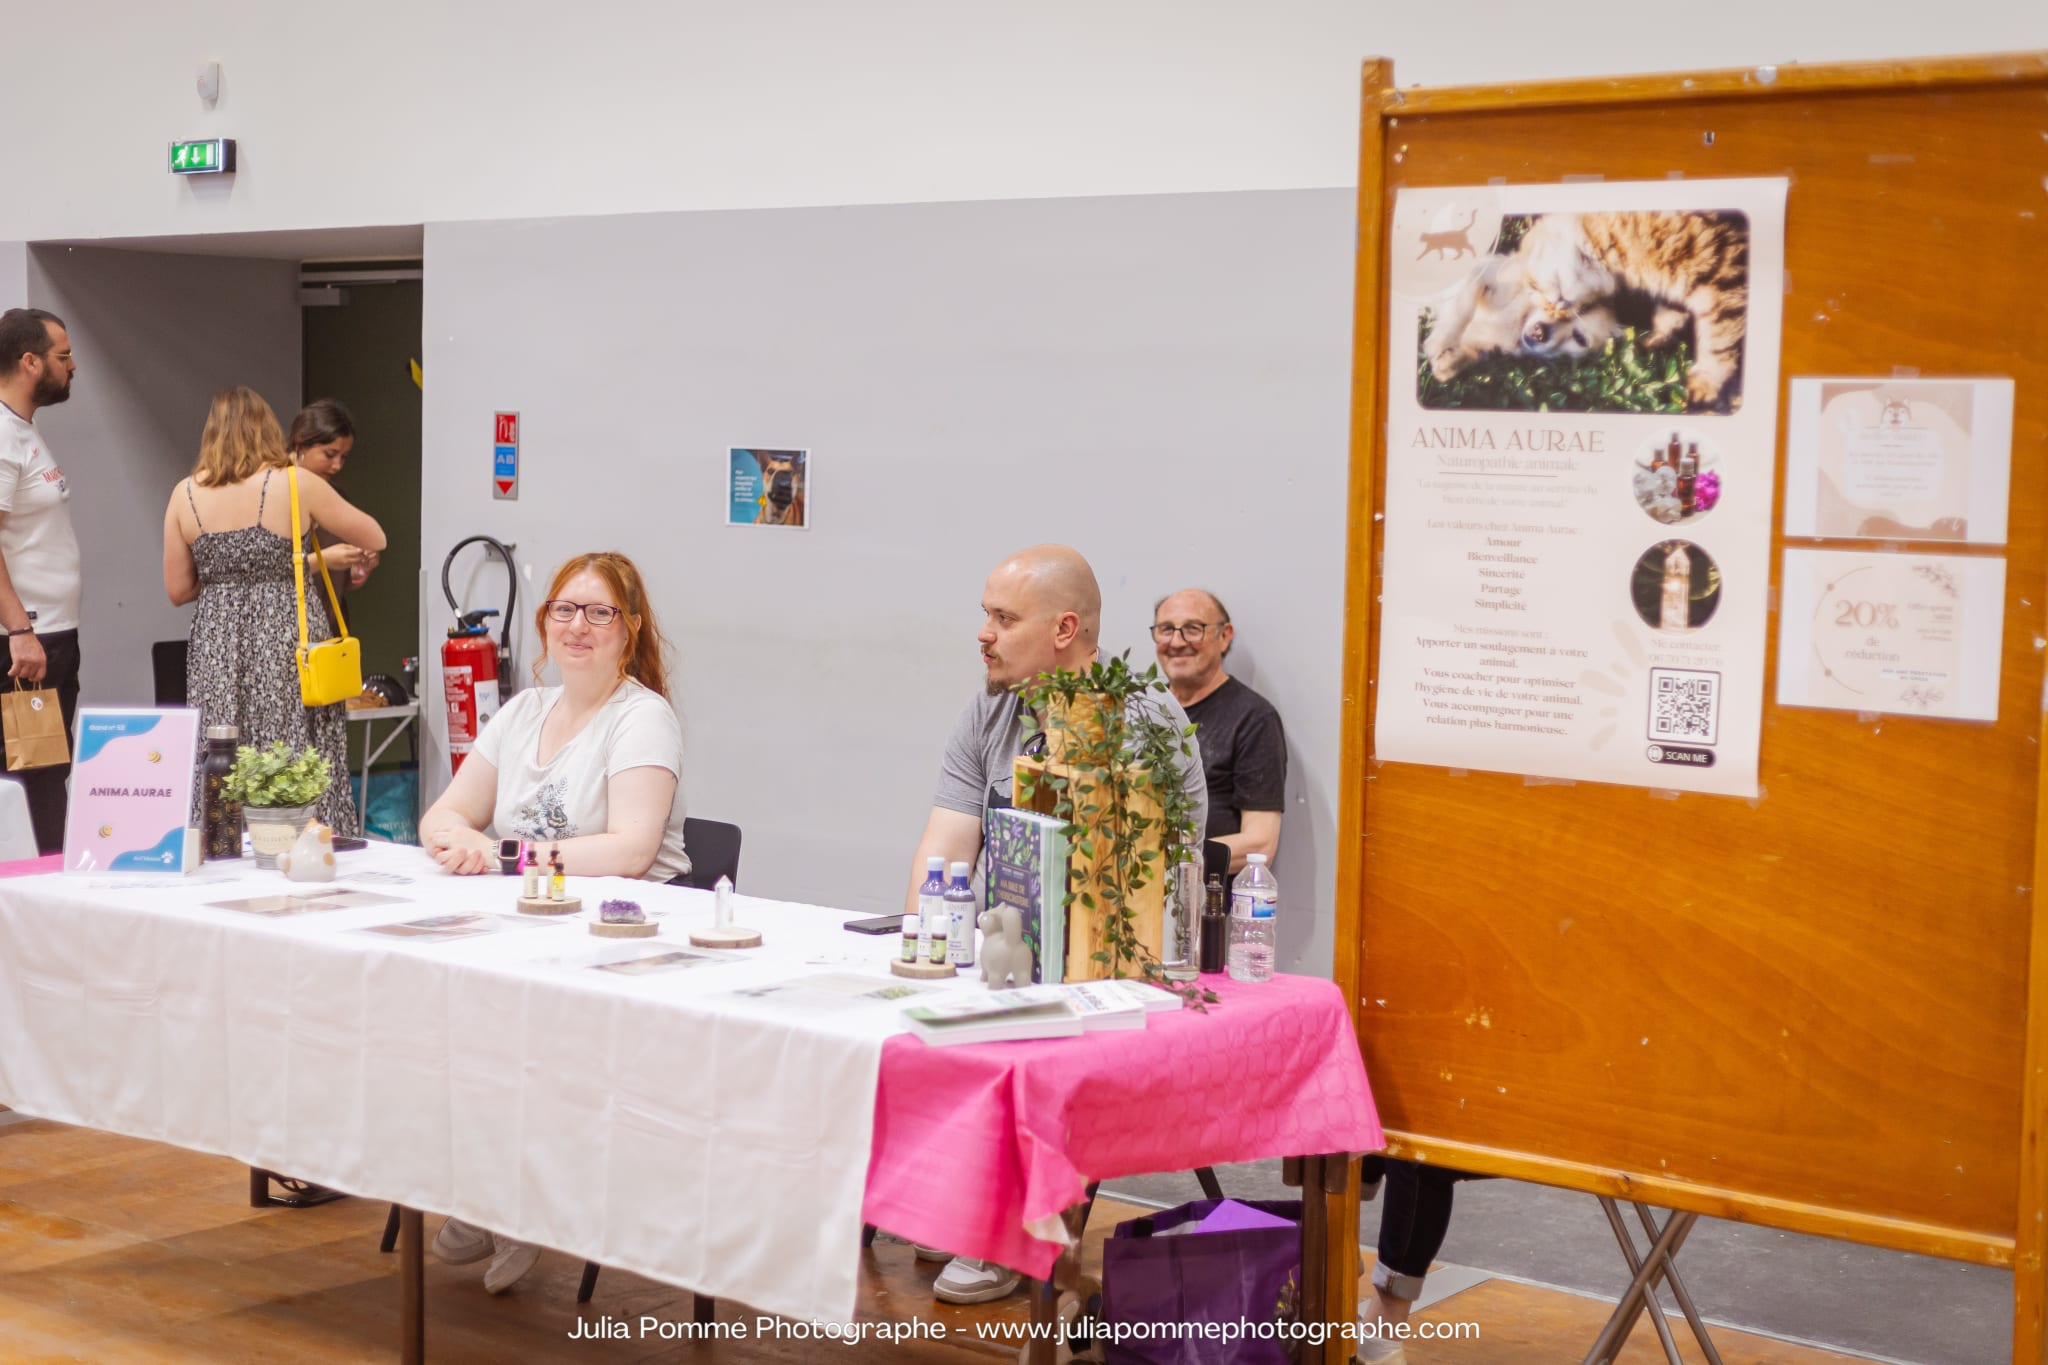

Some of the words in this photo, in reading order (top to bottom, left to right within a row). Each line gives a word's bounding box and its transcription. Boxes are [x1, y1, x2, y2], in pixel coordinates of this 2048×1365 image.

[1410, 427, 1497, 450] ANIMA
[1505, 429, 1605, 453] AURAE
[496, 454, 515, 465] AB
[1436, 454, 1520, 471] Naturopathie
[1525, 457, 1580, 471] animale
[1485, 536, 1523, 548] Amour
[1467, 551, 1539, 565] Bienveillance
[1478, 567, 1526, 580] Sincérité
[1480, 583, 1523, 597] Partage
[1474, 598, 1529, 612] Simplicité
[1834, 599, 1900, 630] 20%
[1414, 635, 1461, 649] Apporter
[1463, 640, 1478, 650] un
[1479, 641, 1547, 656] soulagement
[1559, 647, 1589, 659] votre
[1865, 635, 1880, 648] de
[1844, 648, 1900, 662] réduction
[1479, 657, 1520, 669] animal.
[1423, 667, 1450, 679] Vous
[1451, 669, 1493, 682] coacher
[1495, 673, 1521, 686] pour
[1523, 676, 1577, 690] optimiser
[1461, 685, 1475, 696] de
[1477, 687, 1493, 698] vie
[1495, 688, 1509, 699] de
[1511, 691, 1540, 702] votre
[1541, 692, 1584, 706] animal.
[1422, 697, 1449, 710] Vous
[1450, 702, 1523, 718] accompagner
[1524, 707, 1551, 720] pour
[1553, 710, 1575, 721] une
[1425, 714, 1468, 727] relation
[1469, 717, 1493, 731] plus
[1493, 719, 1569, 737] harmonieuse.
[1666, 751, 1691, 762] SCAN
[1692, 753, 1709, 763] ME
[89, 787, 130, 797] ANIMA
[132, 788, 173, 798] AURAE
